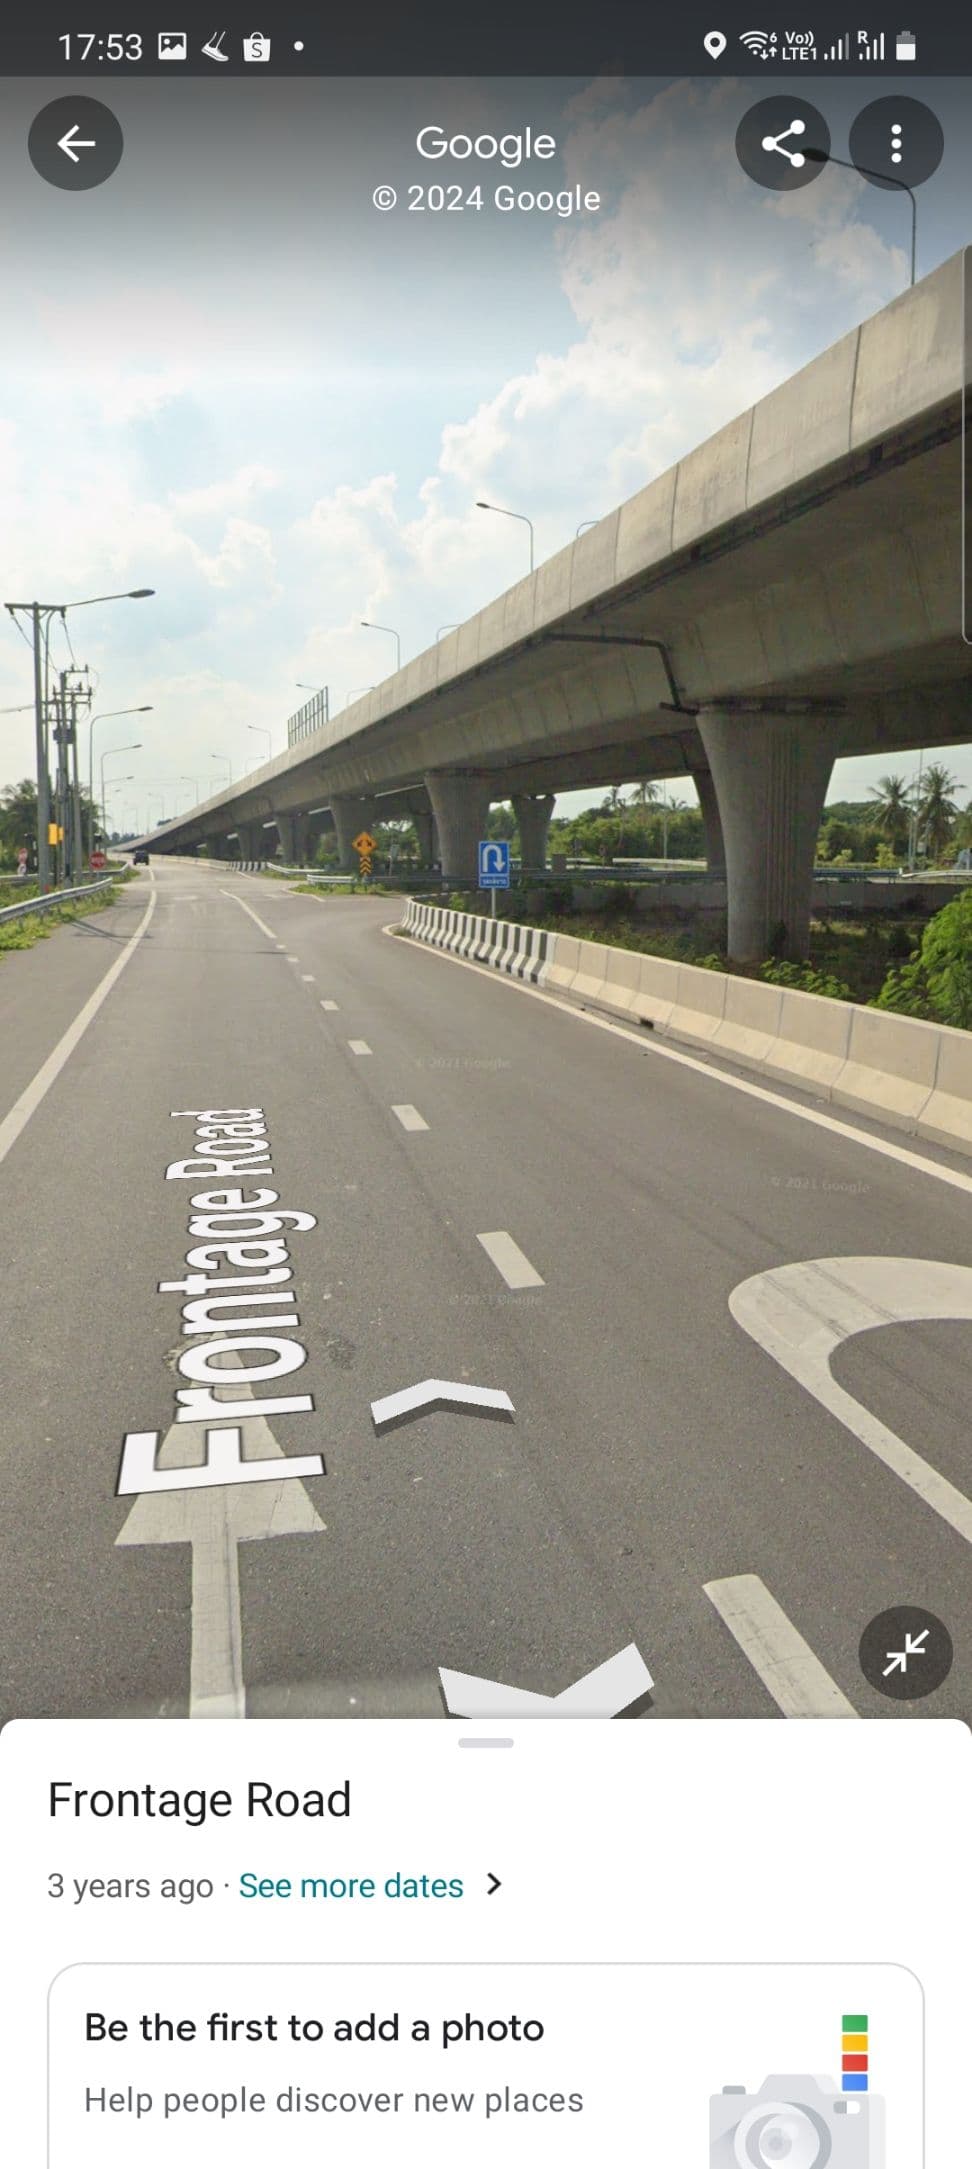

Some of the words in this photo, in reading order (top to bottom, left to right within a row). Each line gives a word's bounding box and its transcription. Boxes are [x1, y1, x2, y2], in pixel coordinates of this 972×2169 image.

[58, 33, 143, 61] 17:53
[782, 46, 817, 60] LTE1
[857, 31, 868, 44] R
[416, 126, 556, 168] Google
[50, 1780, 233, 1827] Frontage
[247, 1779, 351, 1818] Road
[48, 1873, 64, 1899] 3
[73, 1878, 151, 1905] years
[160, 1878, 214, 1905] ago
[239, 1872, 292, 1899] See
[301, 1878, 376, 1899] more
[384, 1871, 464, 1899] dates
[85, 2012, 129, 2042] Be
[138, 2012, 197, 2042] the
[206, 2011, 278, 2042] first
[287, 2014, 324, 2042] to
[333, 2012, 399, 2042] add
[410, 2019, 430, 2042] a
[442, 2012, 545, 2050] photo
[85, 2085, 153, 2120] Help
[164, 2085, 266, 2120] people
[276, 2085, 404, 2113] discover
[414, 2092, 475, 2113] new
[485, 2085, 584, 2120] places
